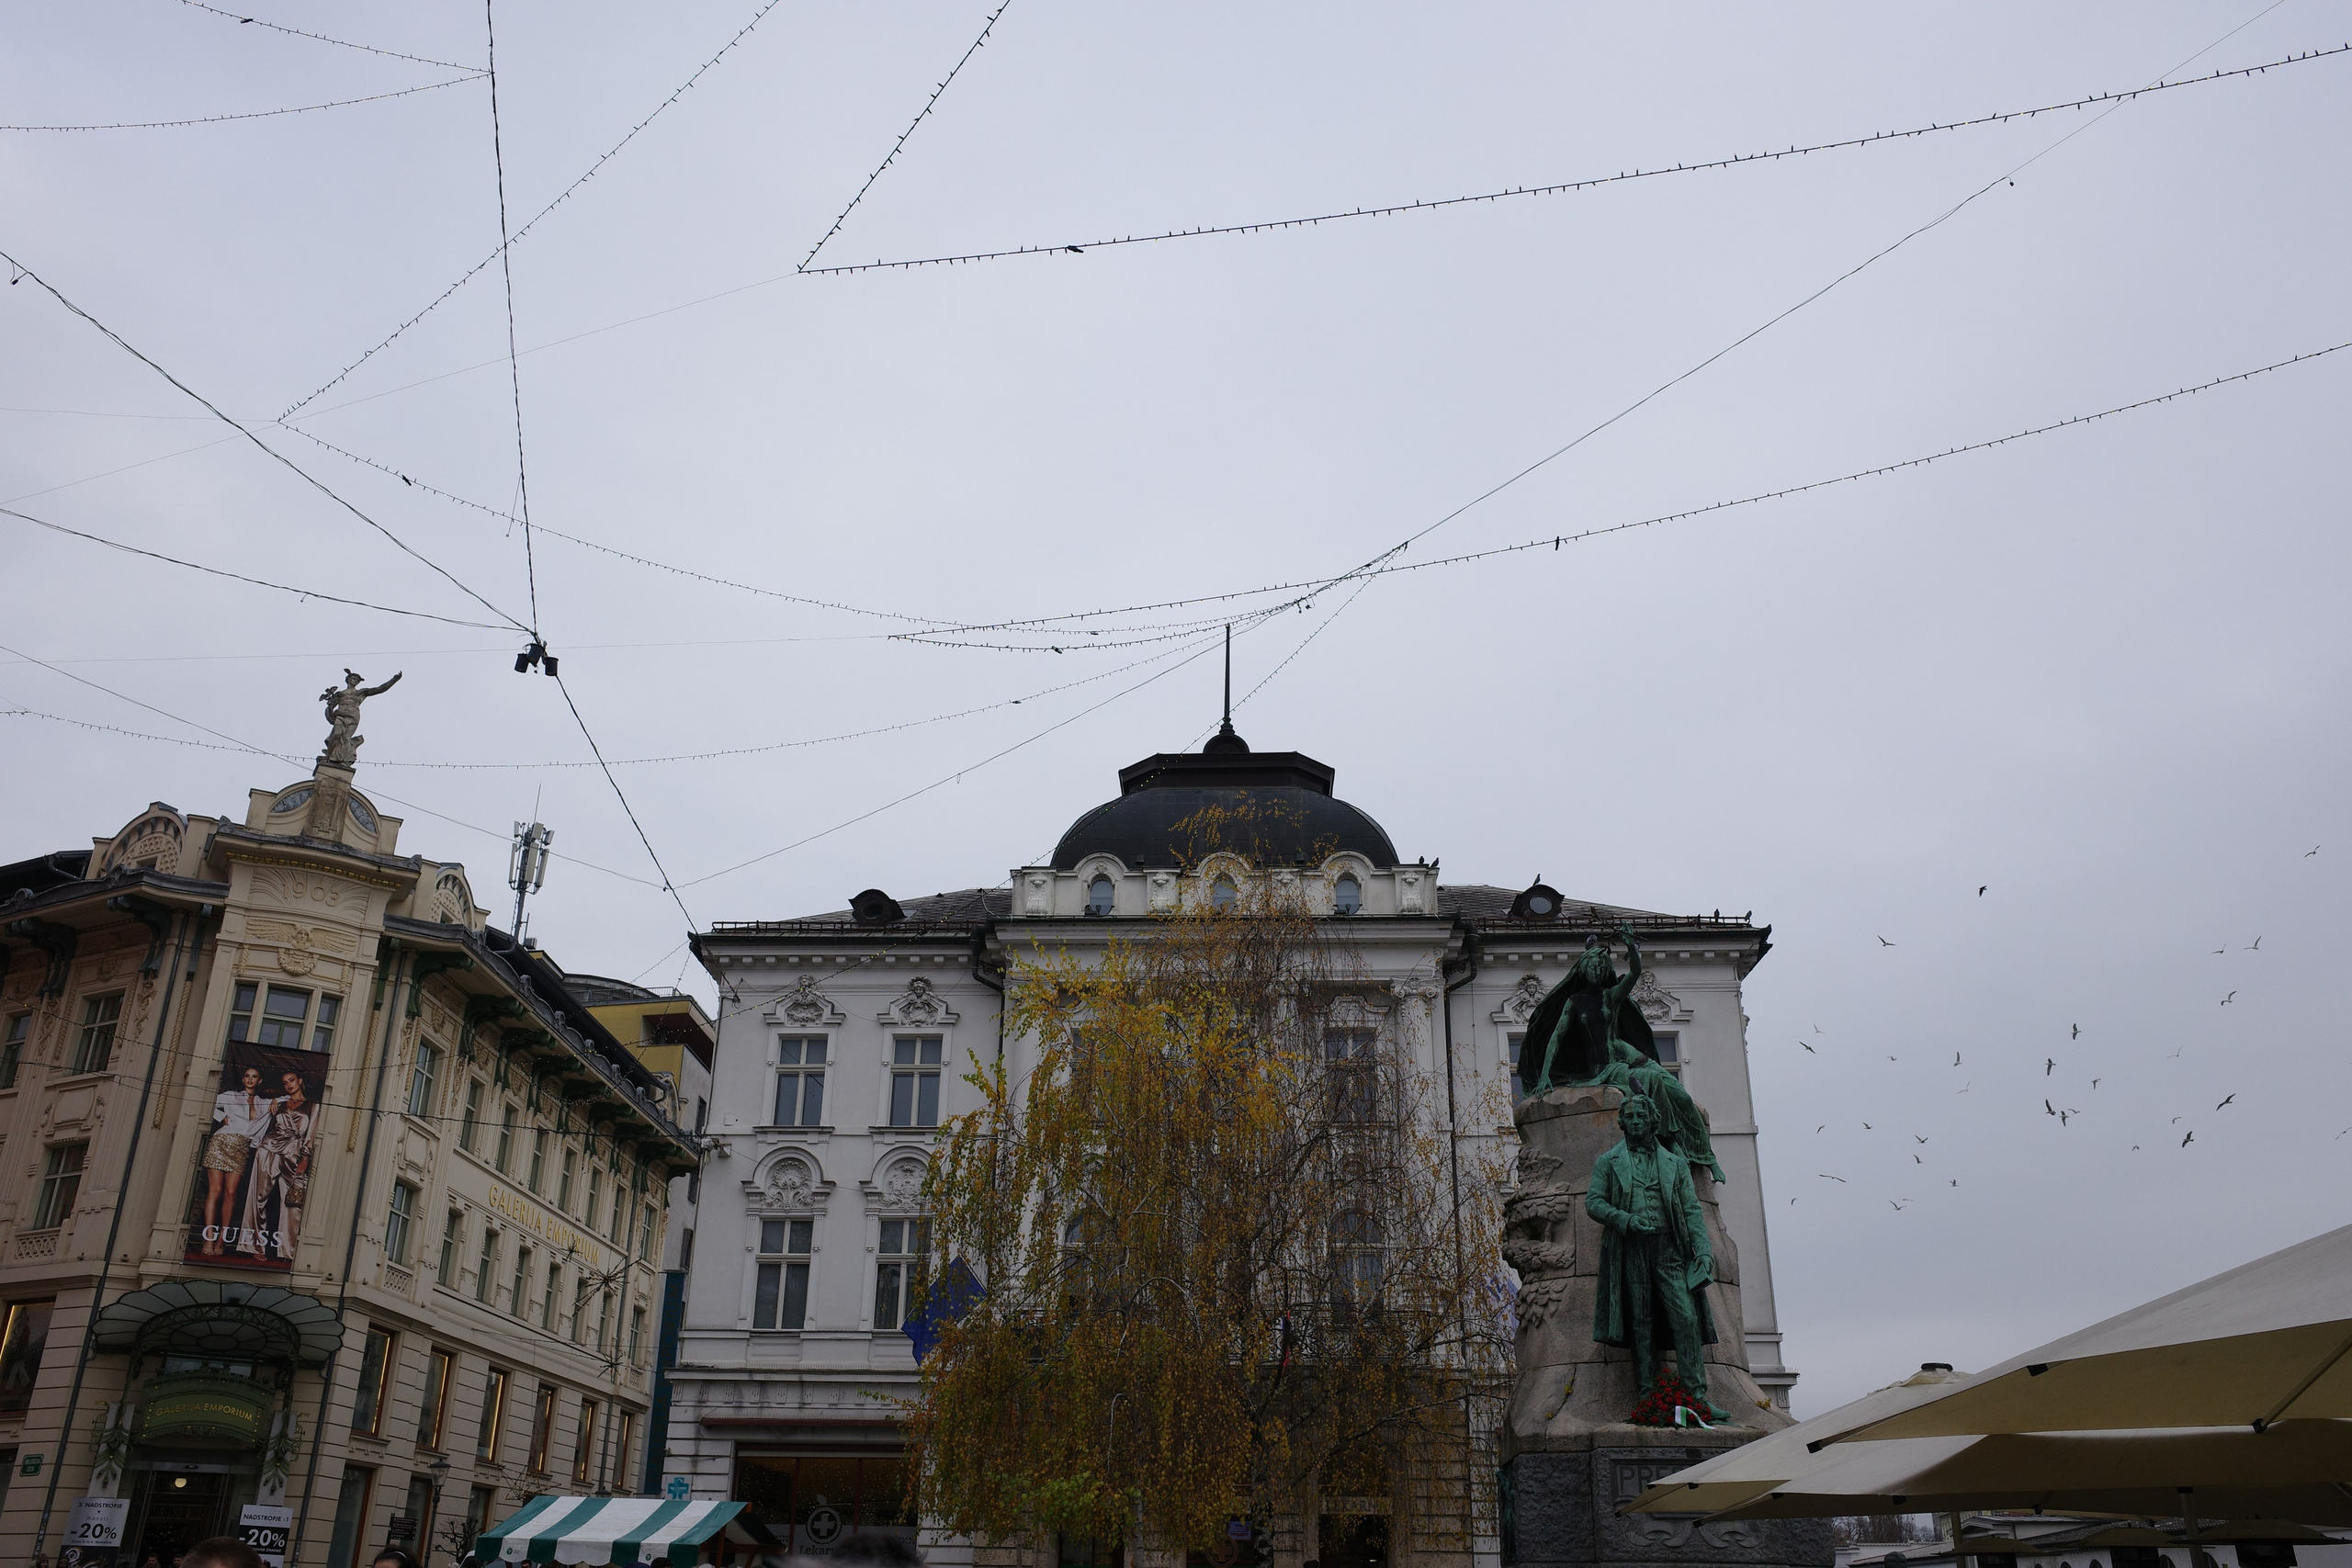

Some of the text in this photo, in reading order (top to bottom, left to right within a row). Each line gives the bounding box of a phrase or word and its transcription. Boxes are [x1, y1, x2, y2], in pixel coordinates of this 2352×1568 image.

[281, 882, 339, 907] 1903
[489, 1183, 600, 1267] GALERIJA EMPORIUM
[201, 1224, 284, 1247] GUESS
[155, 1403, 253, 1422] GALERIJA EMPORIUM
[243, 1514, 282, 1522] NADSTROPJE
[70, 1522, 117, 1540] -20%
[239, 1529, 286, 1548] -20%
